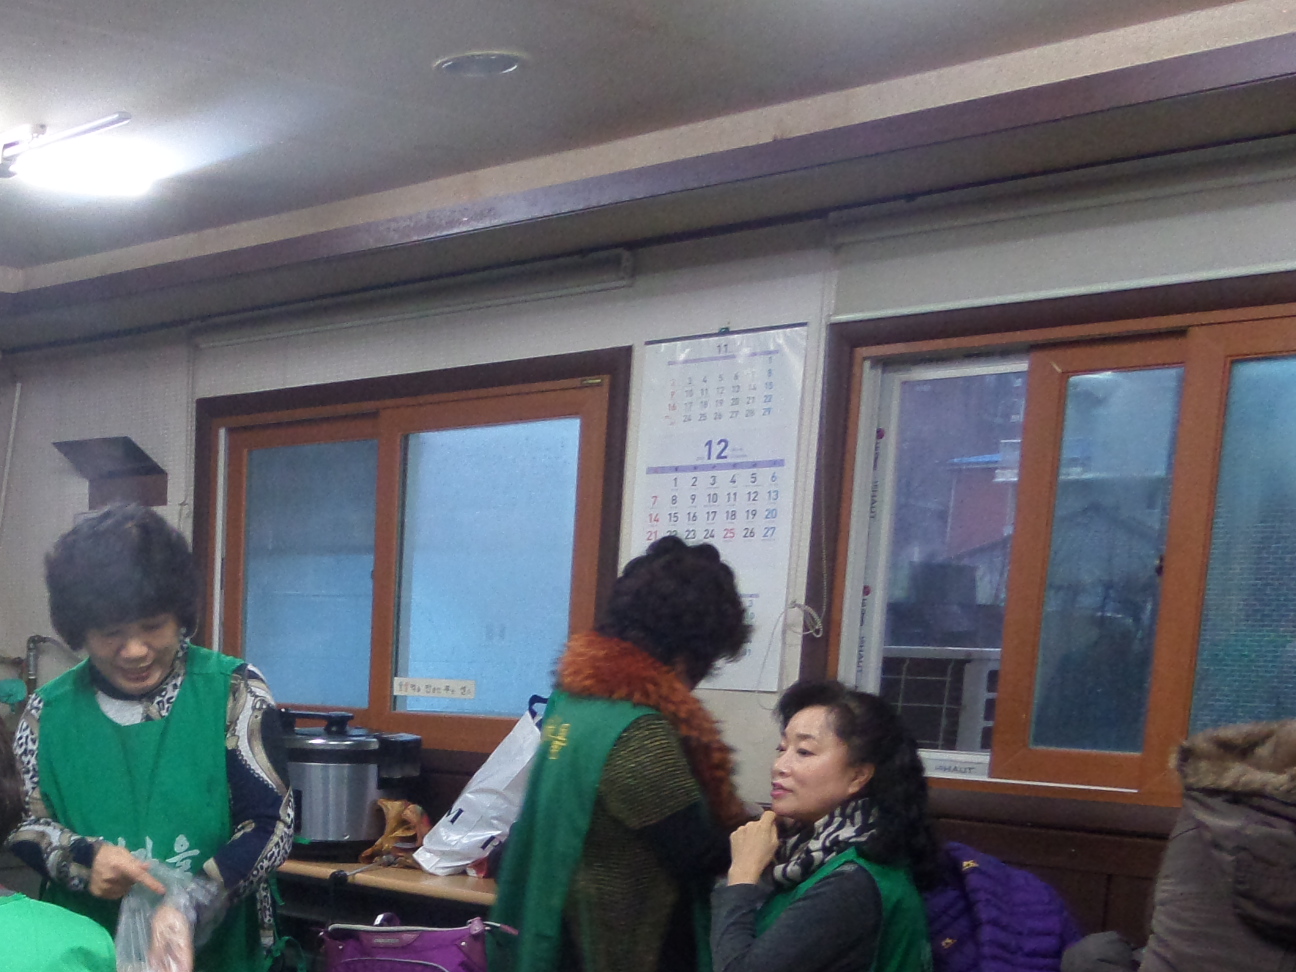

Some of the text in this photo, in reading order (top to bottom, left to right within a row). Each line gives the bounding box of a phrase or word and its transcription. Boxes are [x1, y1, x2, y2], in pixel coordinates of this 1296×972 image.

[717, 344, 728, 354] 11
[698, 413, 707, 422] 25
[729, 410, 740, 419] 27
[704, 438, 729, 460] 12
[672, 471, 777, 487] 1 2 3 4 5 6
[651, 490, 779, 505] 7 8 9 10 11 12 13
[648, 508, 777, 523] 14 15 16 17 18 19 20
[646, 530, 658, 541] 21
[685, 529, 697, 539] 23
[704, 529, 715, 539] 24
[723, 528, 735, 539] 25
[743, 527, 755, 538] 26
[762, 526, 776, 538] 27
